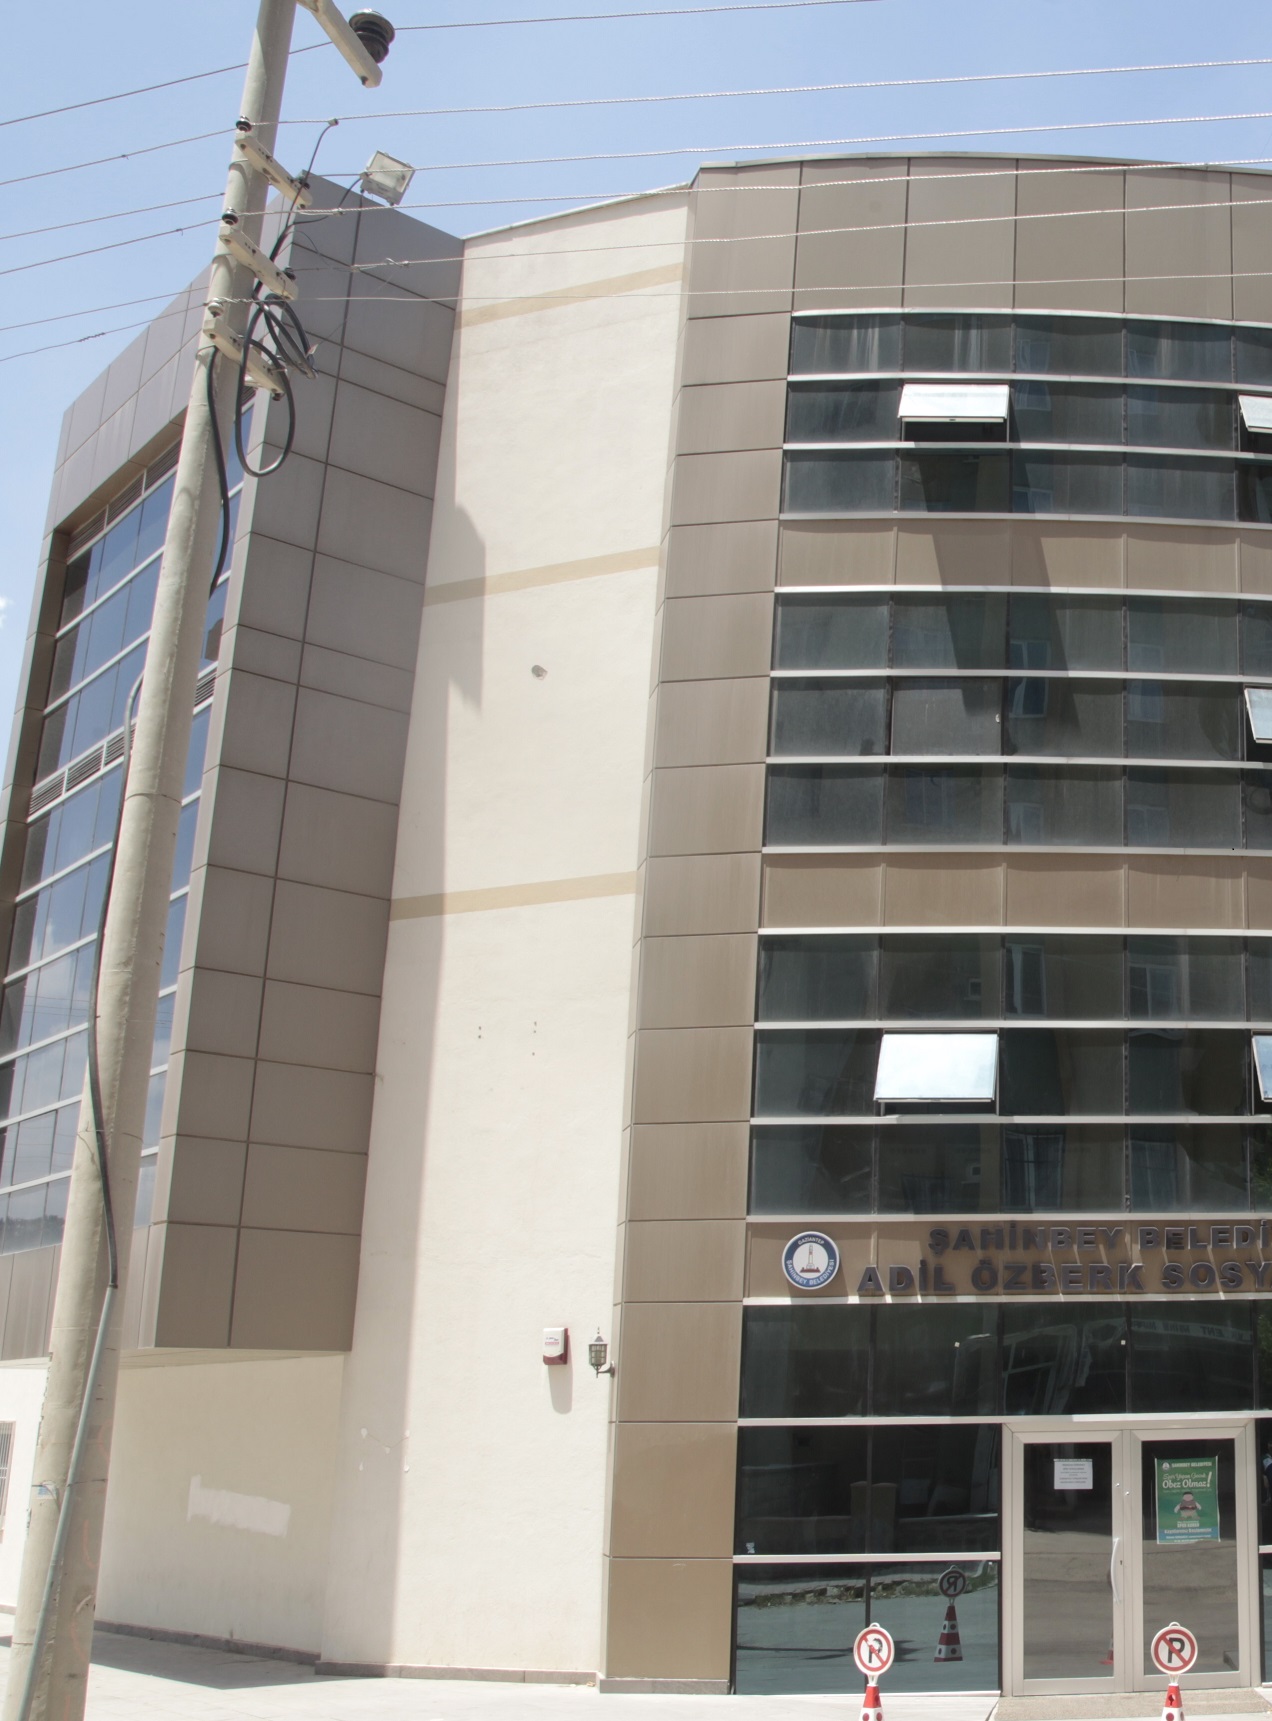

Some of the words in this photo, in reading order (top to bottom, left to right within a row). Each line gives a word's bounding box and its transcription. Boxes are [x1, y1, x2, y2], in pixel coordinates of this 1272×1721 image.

[928, 1220, 1124, 1256] ŞAHİNBEY
[857, 1259, 956, 1292] ADİL
[971, 1258, 1145, 1291] ÖZBERK
[1162, 1480, 1181, 1489] Obez
